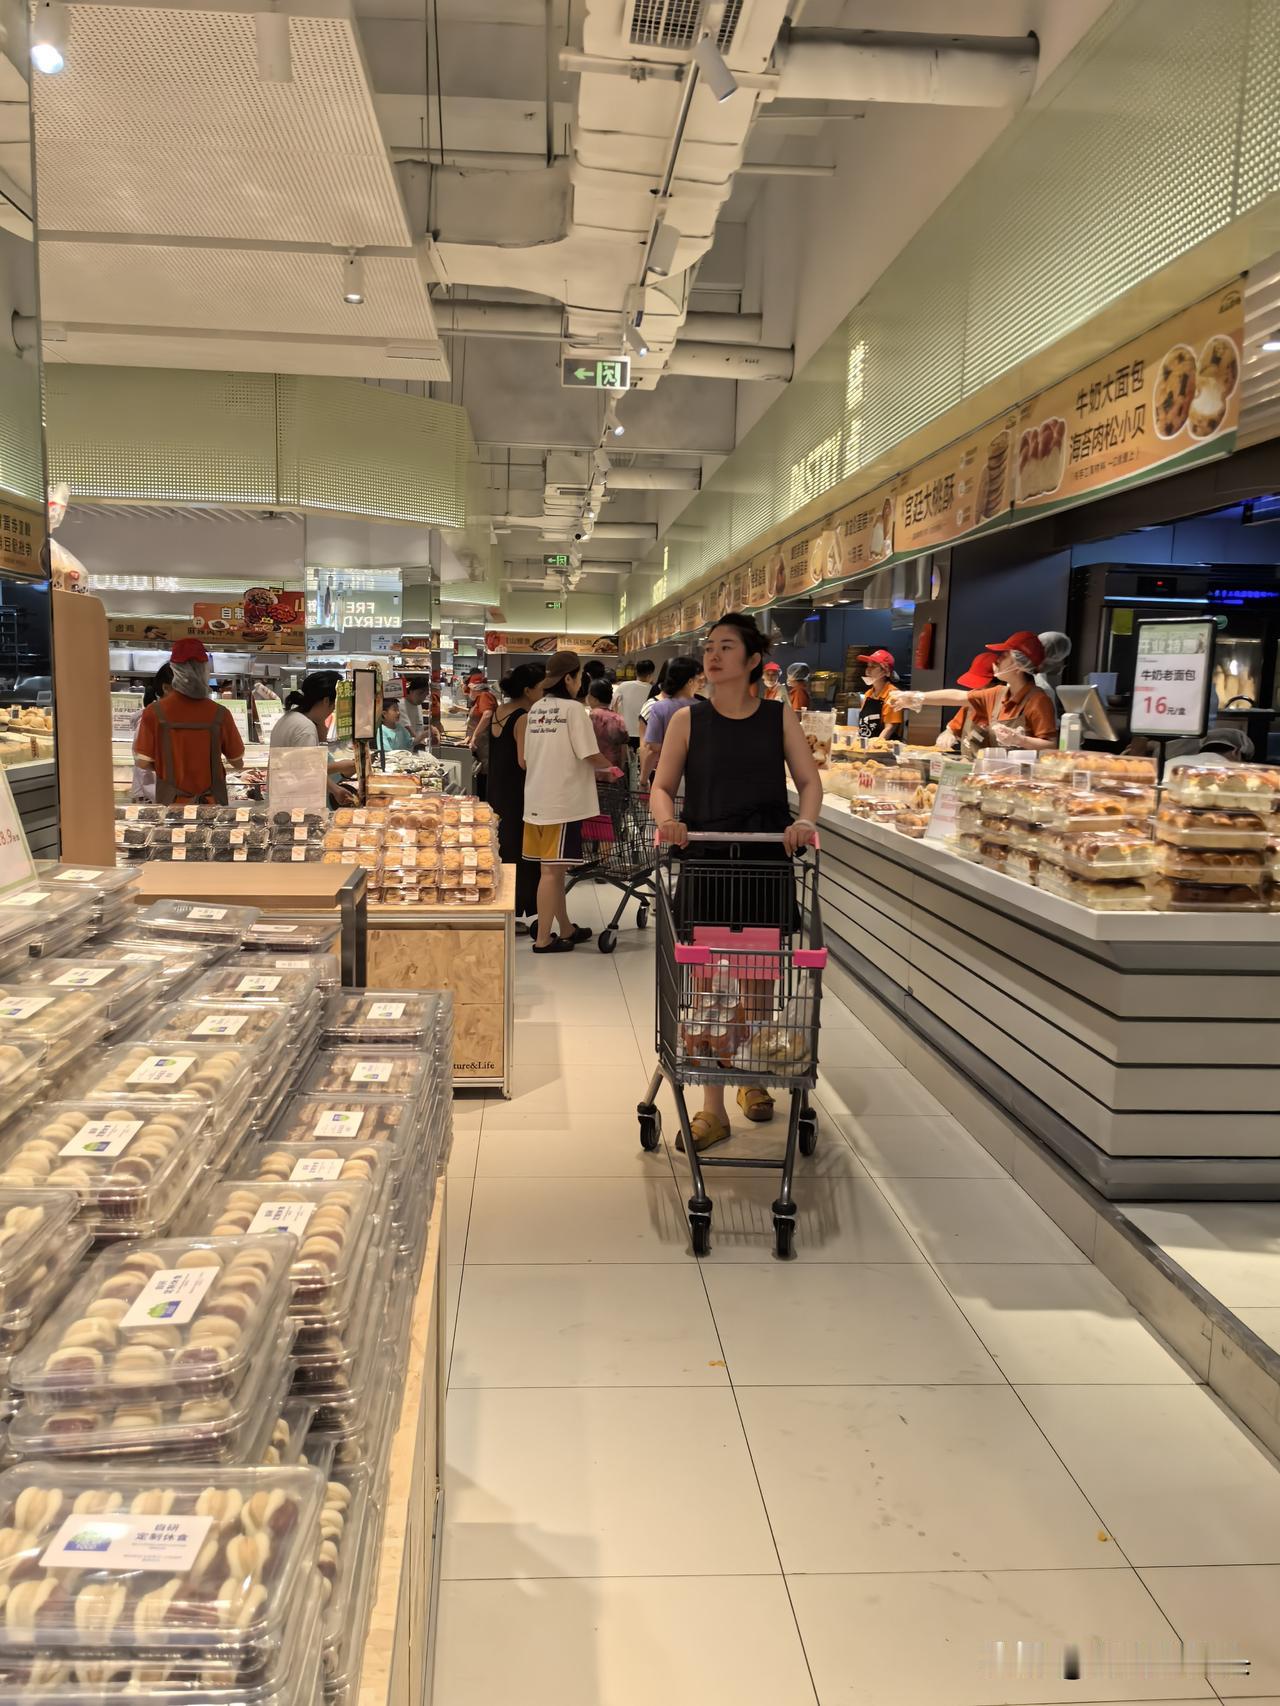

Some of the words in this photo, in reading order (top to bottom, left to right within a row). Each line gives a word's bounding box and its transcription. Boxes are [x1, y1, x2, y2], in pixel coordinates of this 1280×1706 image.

[1075, 359, 1145, 419] 牛奶大面包
[1068, 403, 1146, 465] 海苔肉松小贝
[1141, 669, 1197, 682] 牛奶老面包
[453, 1061, 495, 1070] ture&Life
